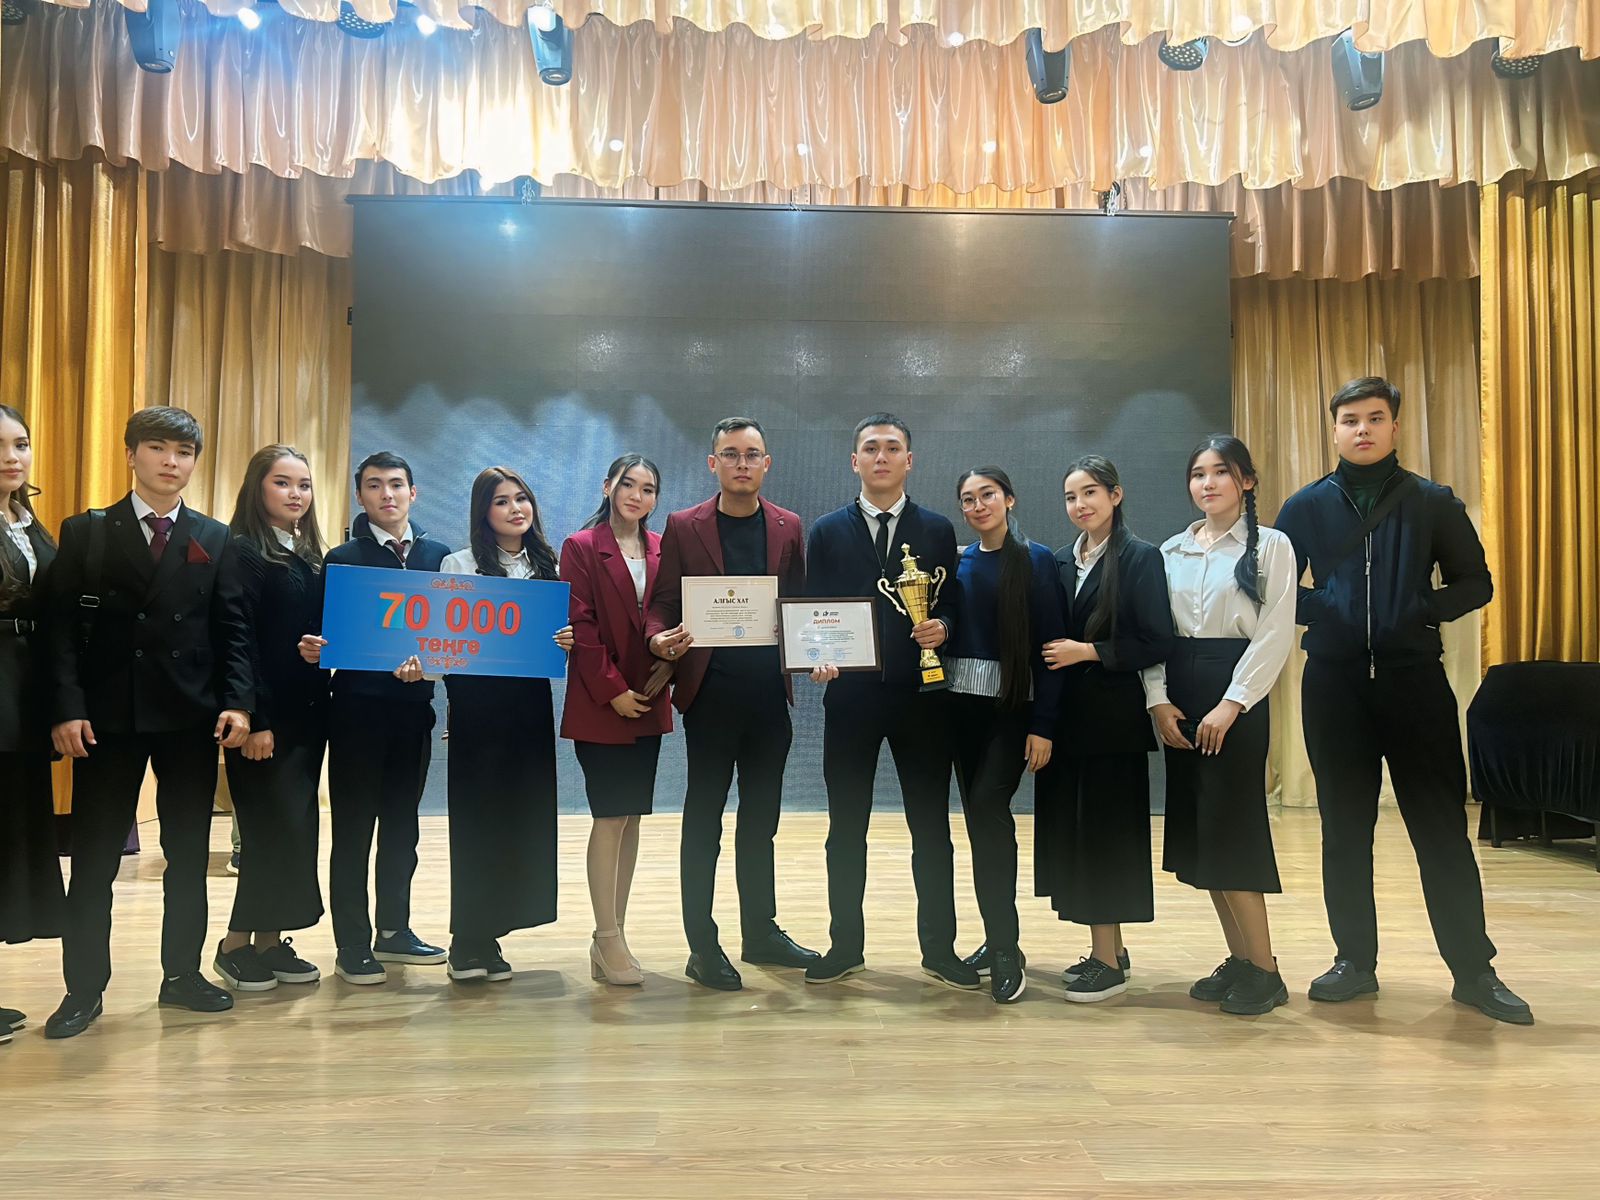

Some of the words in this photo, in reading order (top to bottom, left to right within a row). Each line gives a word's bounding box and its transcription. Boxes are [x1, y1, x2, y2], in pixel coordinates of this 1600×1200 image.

[379, 593, 431, 631] 70
[445, 598, 522, 636] 000
[417, 637, 481, 656] теңге
